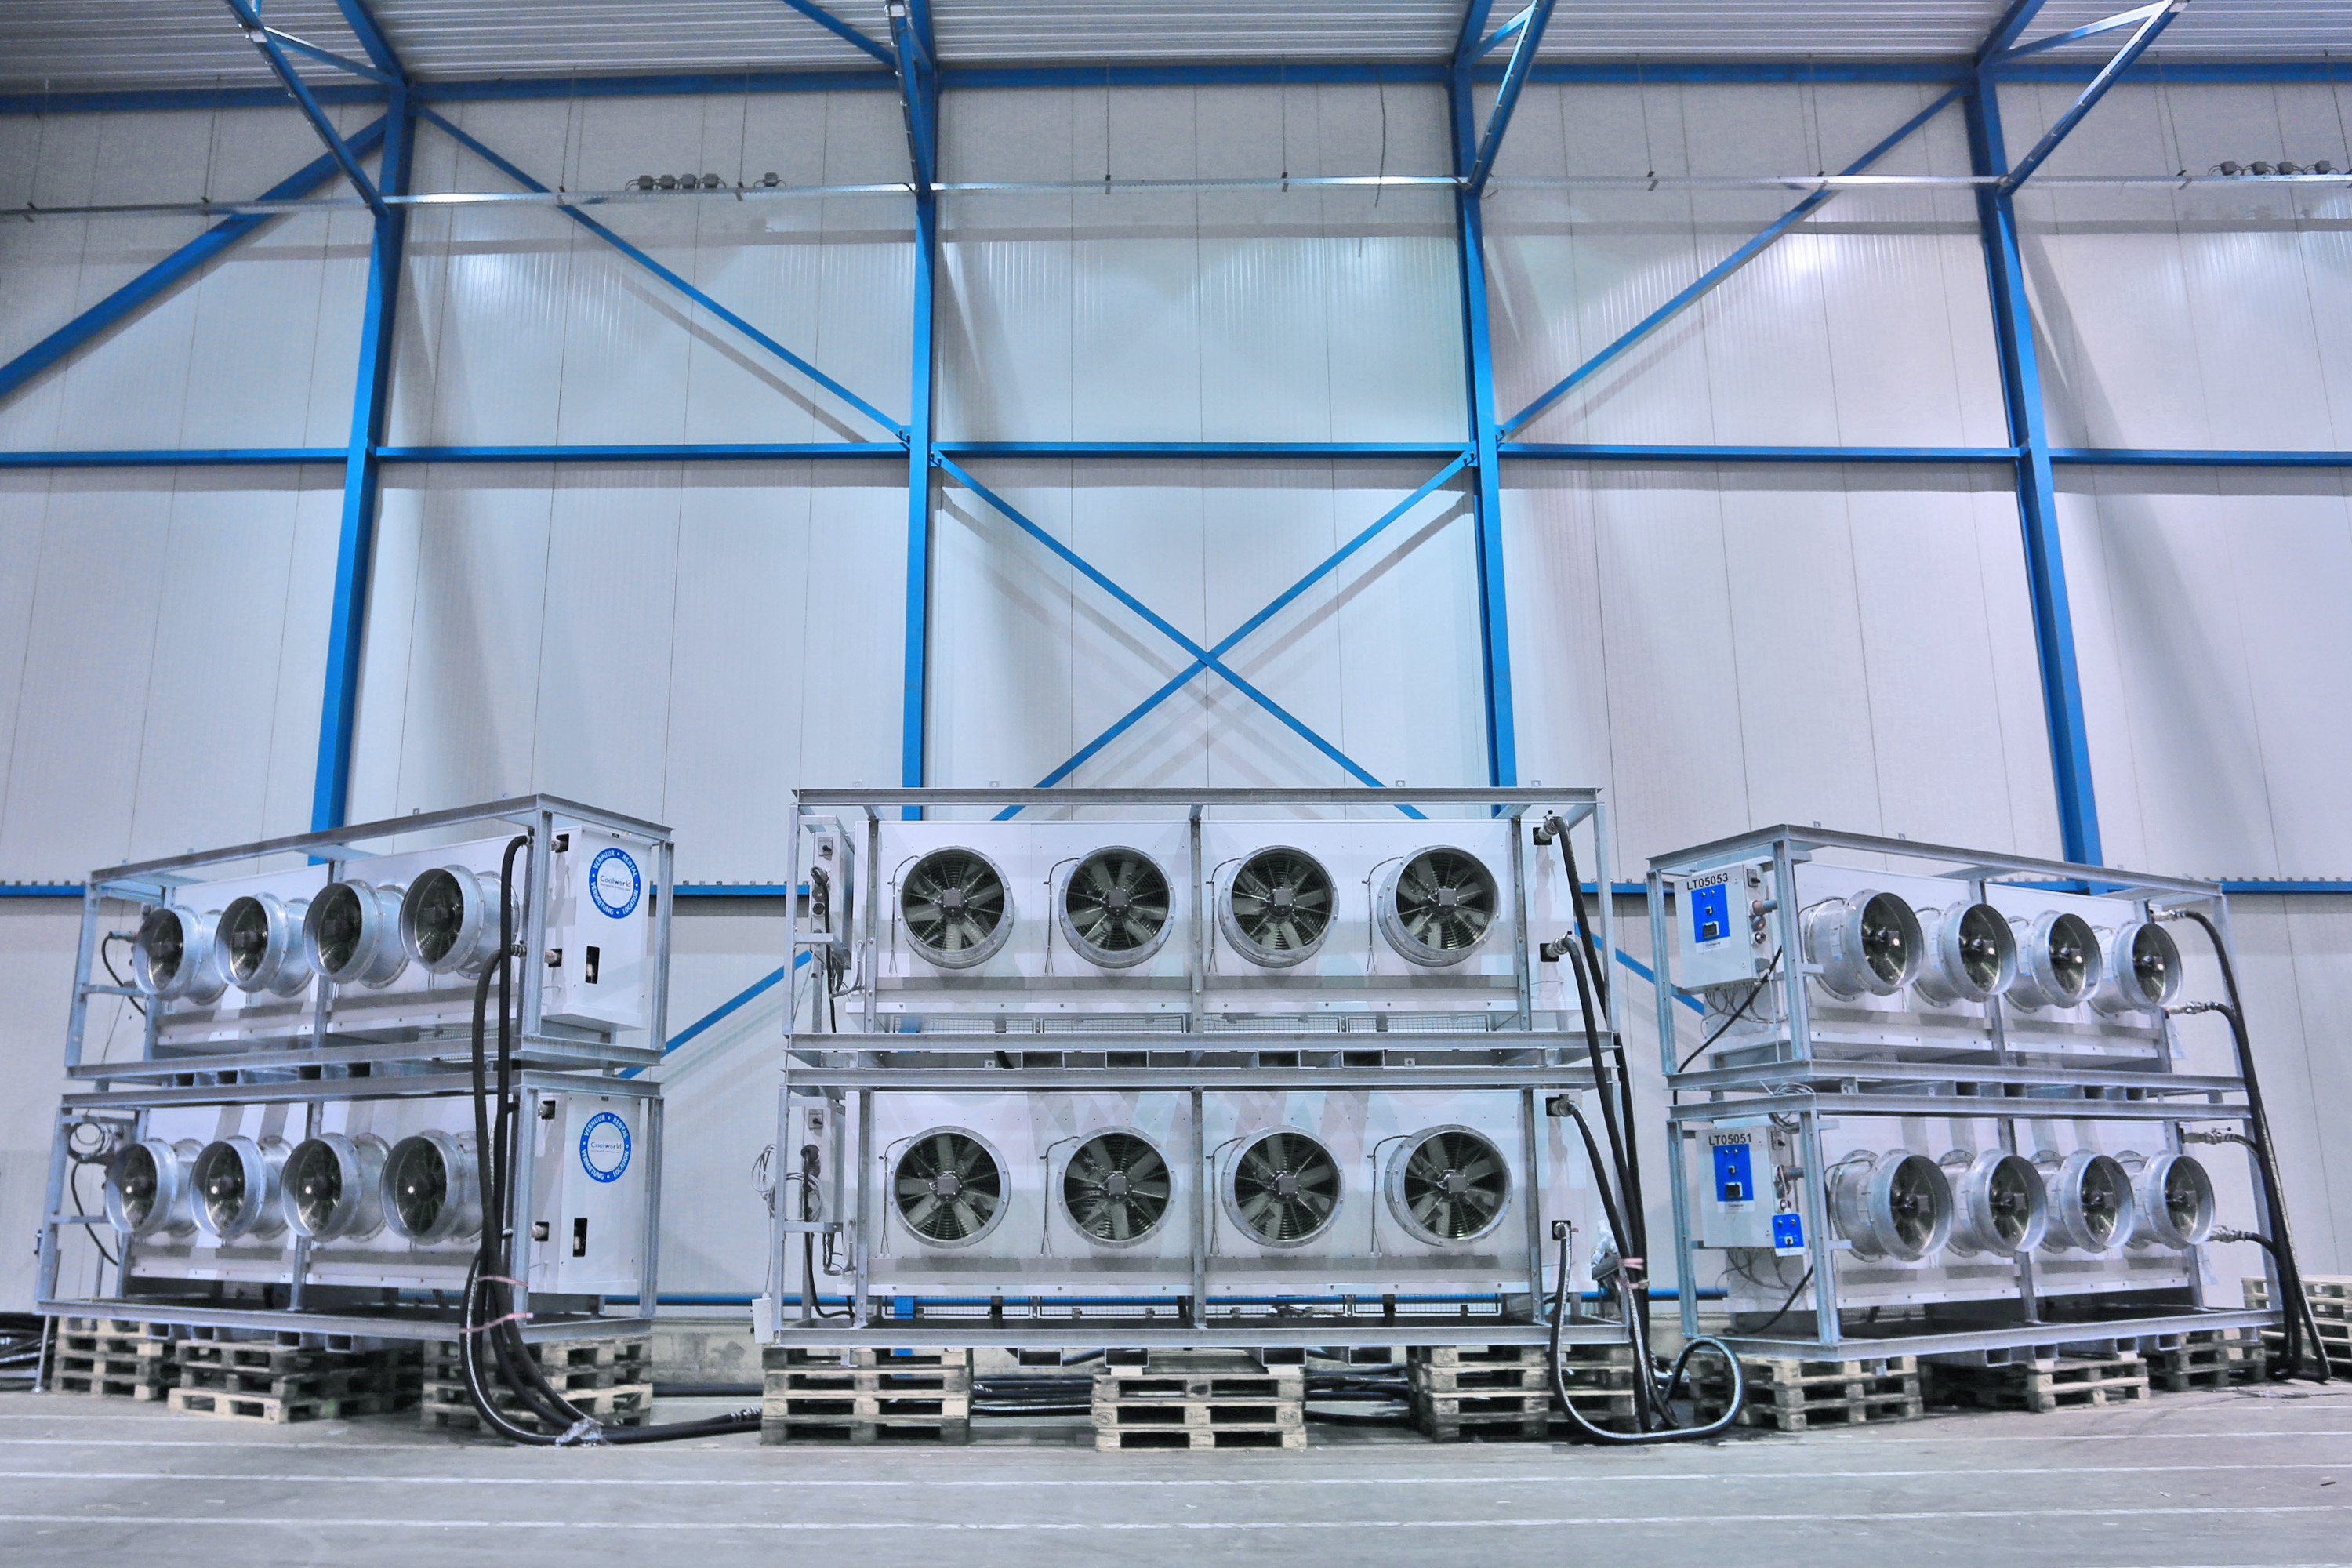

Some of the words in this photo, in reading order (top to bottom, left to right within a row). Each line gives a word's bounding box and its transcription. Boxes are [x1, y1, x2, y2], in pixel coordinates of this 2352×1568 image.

[593, 849, 615, 869] VERHUUR
[622, 854, 637, 877] RENTAL
[600, 875, 631, 887] Coolworld
[1686, 873, 1729, 891] LT05053
[590, 881, 614, 915] VERMIETUNG
[622, 889, 638, 915] LOCATION
[583, 1114, 605, 1136] VERHUUR
[612, 1116, 629, 1138] RENTAL
[1708, 1133, 1751, 1146] LT05051
[612, 1151, 629, 1178] LOCATION
